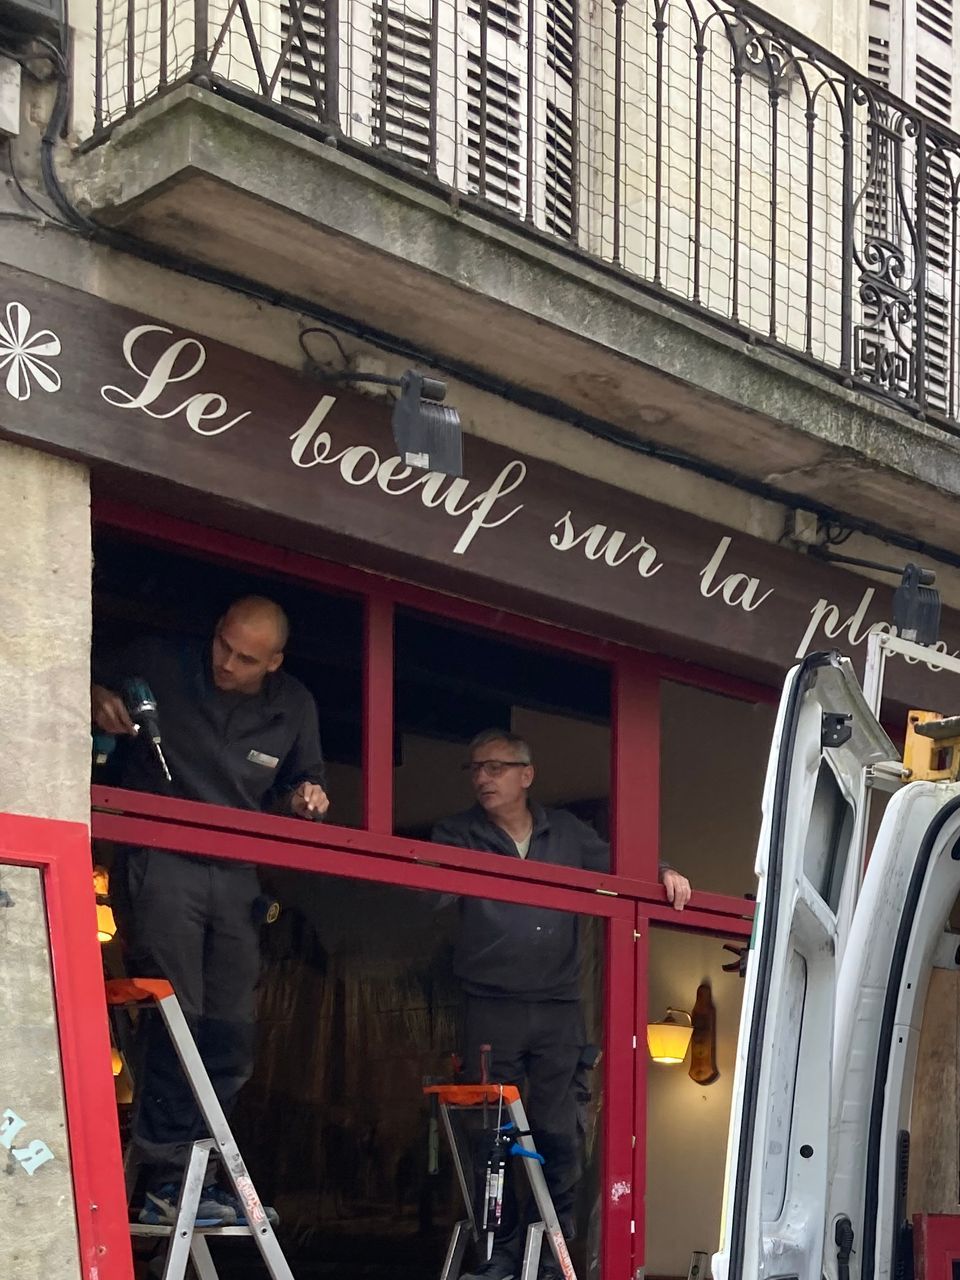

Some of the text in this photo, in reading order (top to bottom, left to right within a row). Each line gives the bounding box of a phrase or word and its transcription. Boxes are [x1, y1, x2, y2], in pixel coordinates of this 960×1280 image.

[100, 323, 252, 437] Le
[289, 394, 527, 555] boeuf
[549, 511, 664, 578] sur
[700, 536, 774, 612] la
